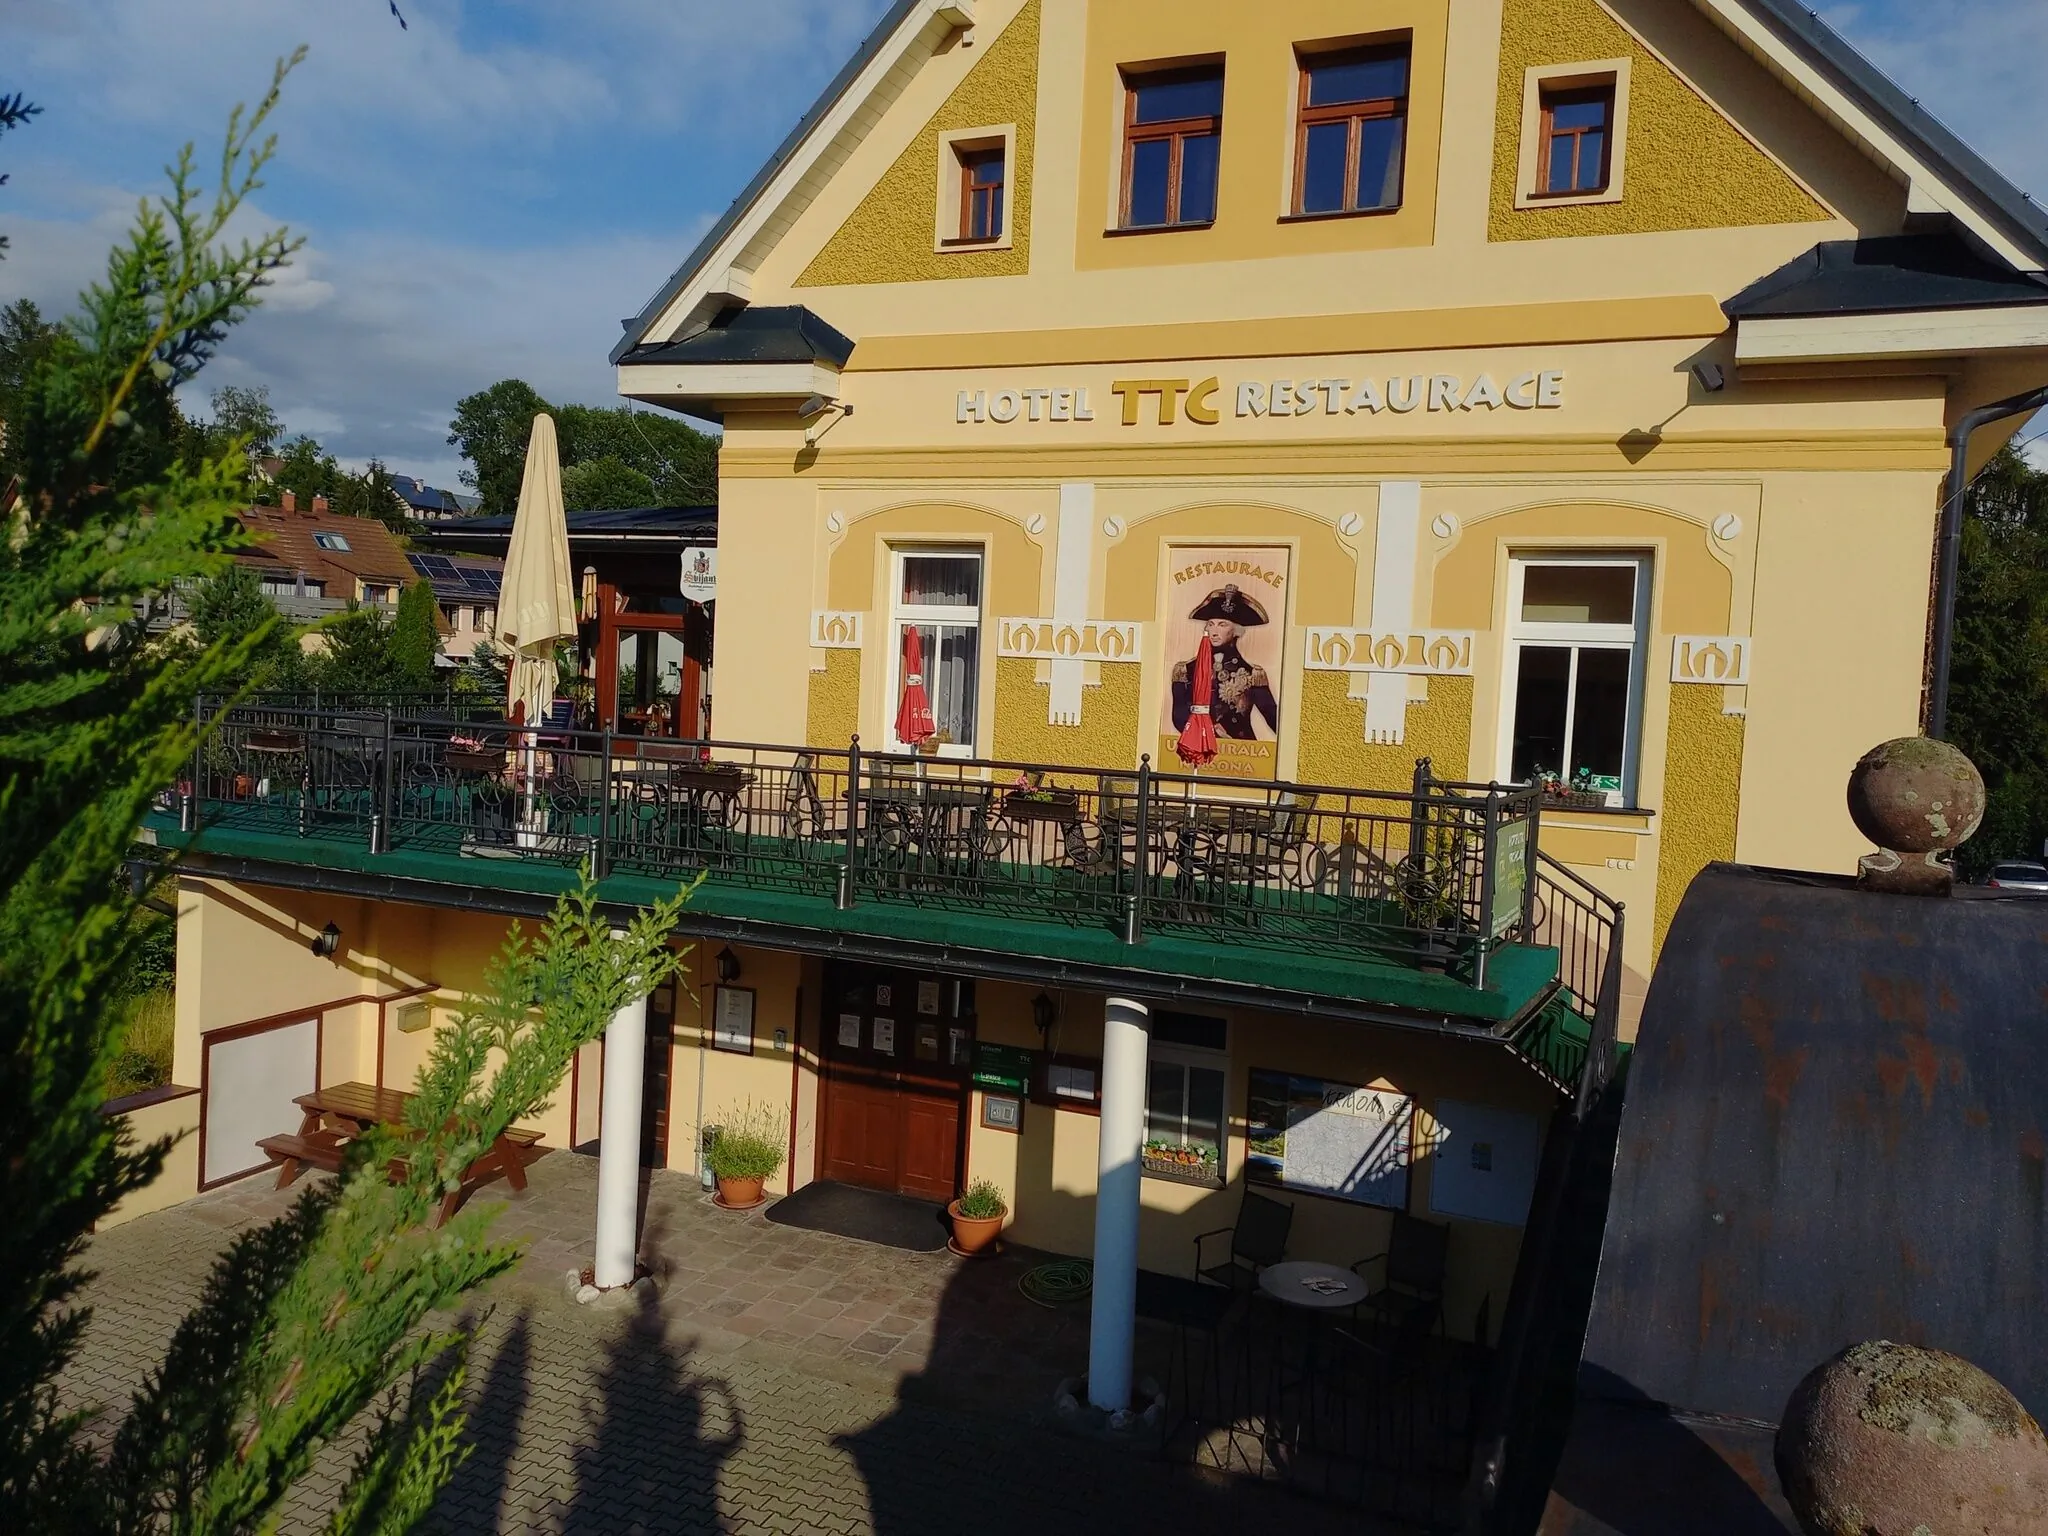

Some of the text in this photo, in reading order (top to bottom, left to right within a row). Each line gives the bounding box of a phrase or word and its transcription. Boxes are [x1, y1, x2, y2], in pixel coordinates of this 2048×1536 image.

[956, 369, 1564, 426] HOTEL TTC RESTAURACE
[1173, 561, 1284, 588] RESTAURACE
